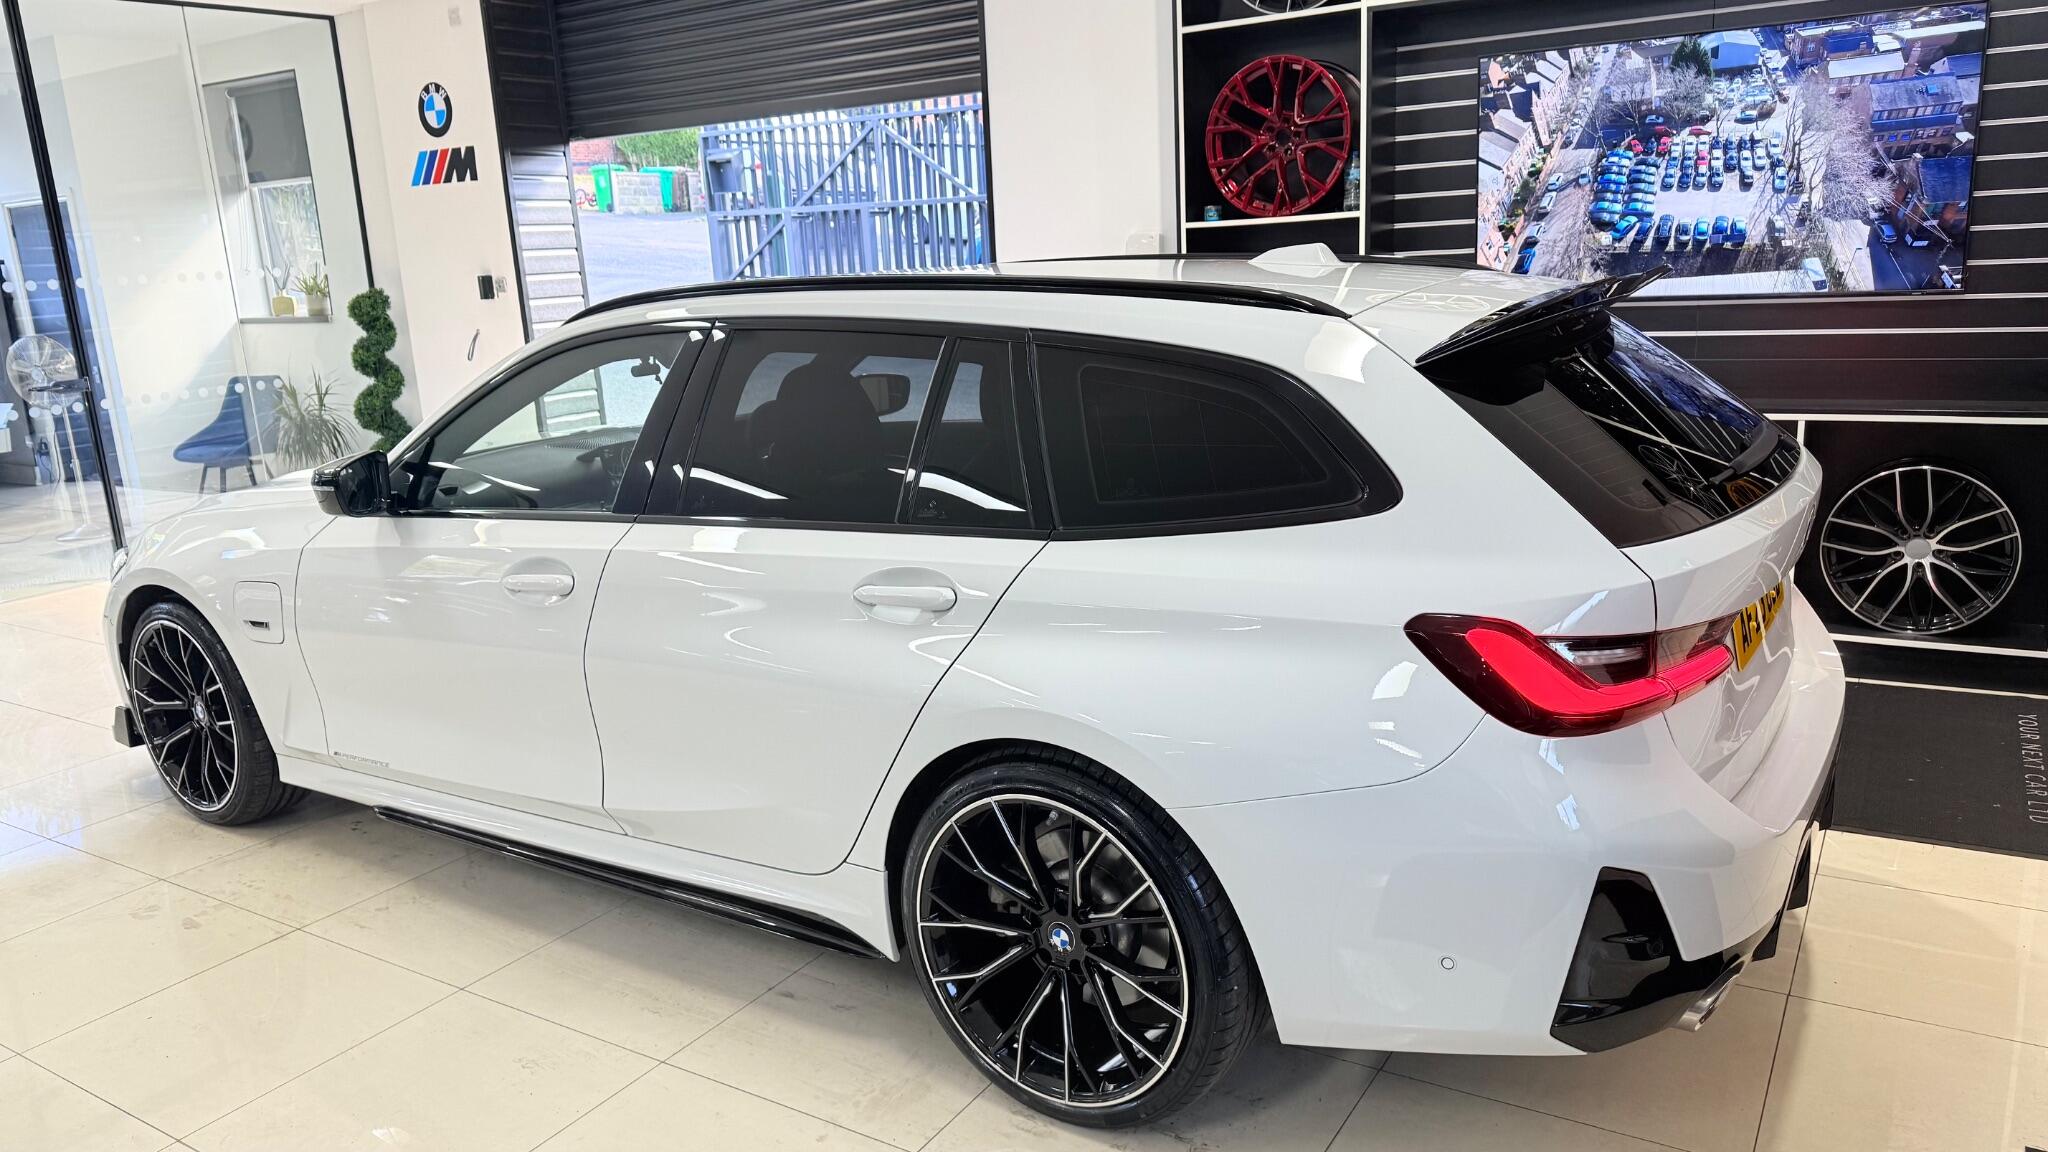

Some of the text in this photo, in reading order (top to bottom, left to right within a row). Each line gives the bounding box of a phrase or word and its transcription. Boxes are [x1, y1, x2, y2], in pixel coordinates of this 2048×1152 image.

[2018, 714, 2040, 740] YOUR
[2020, 742, 2045, 770] NEXT
[2024, 774, 2048, 796] CAR
